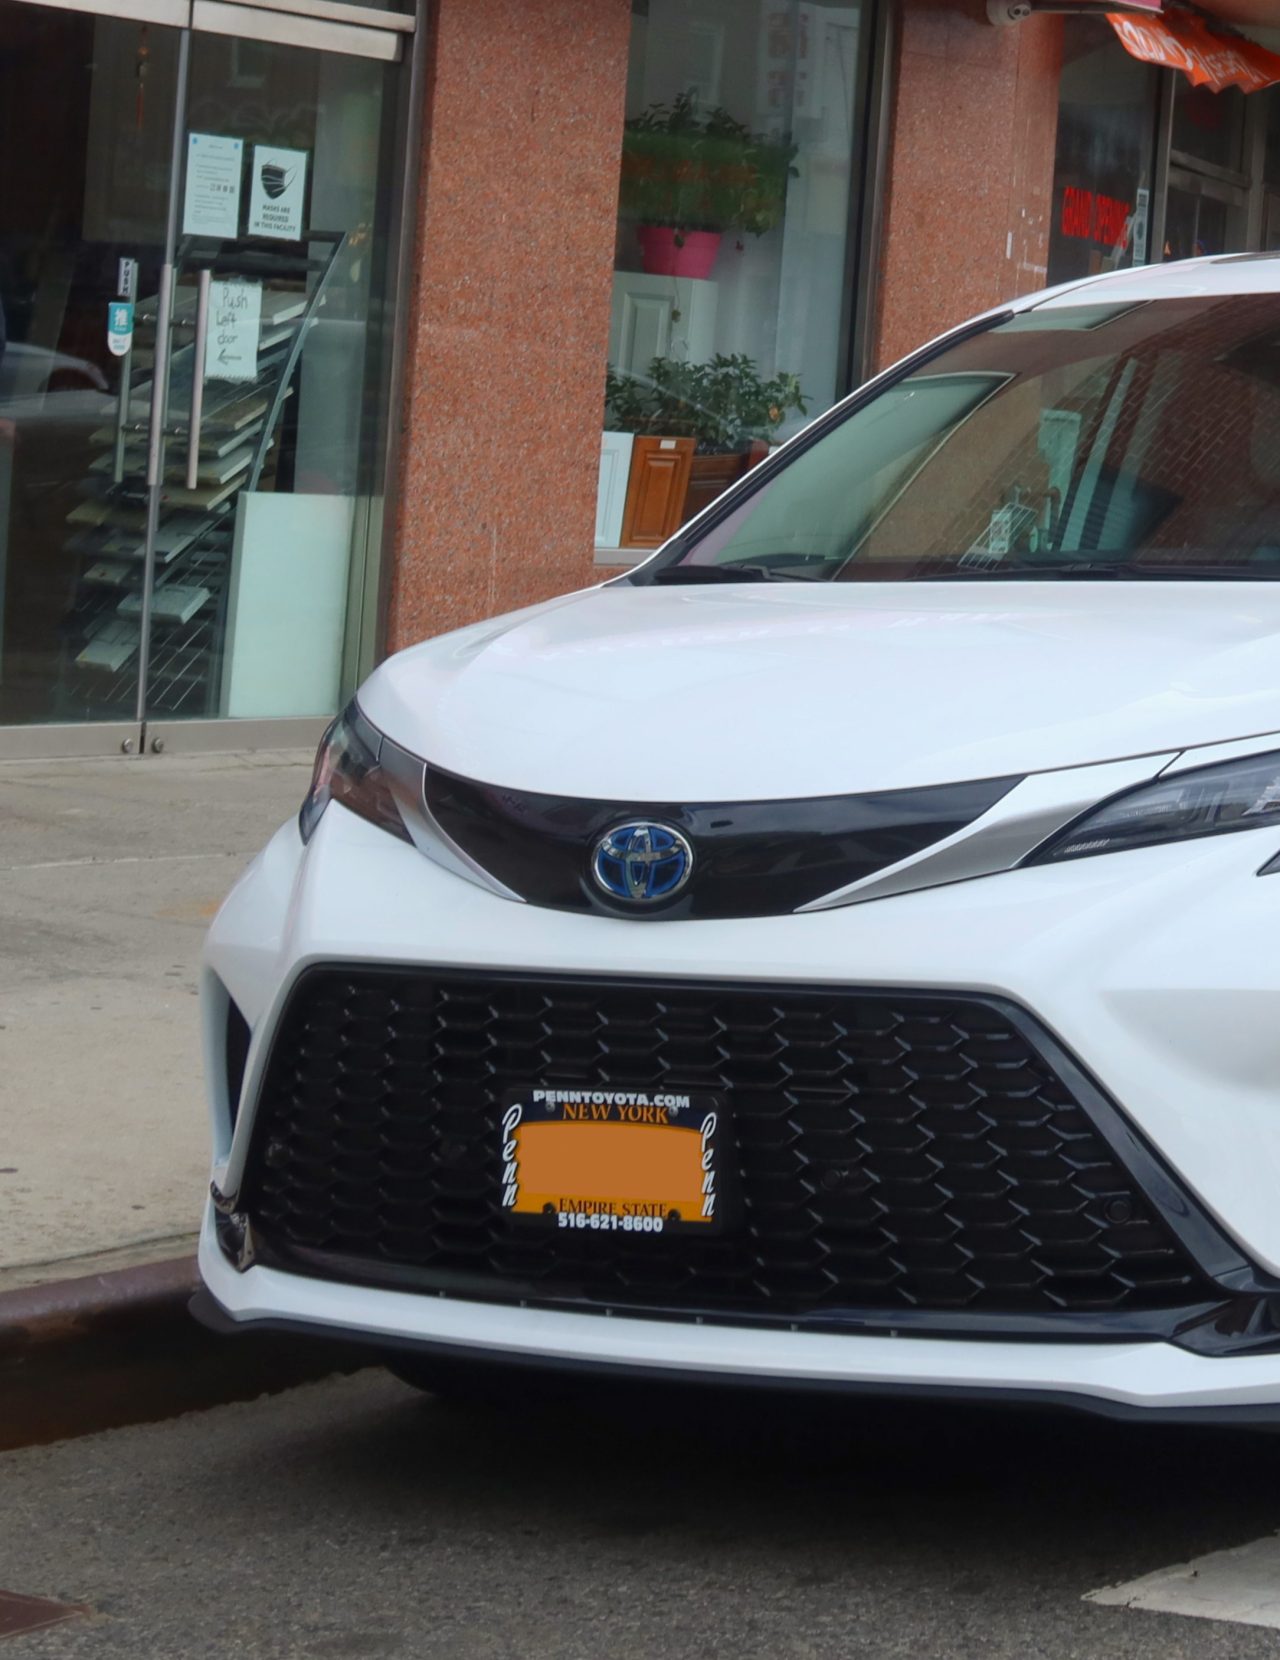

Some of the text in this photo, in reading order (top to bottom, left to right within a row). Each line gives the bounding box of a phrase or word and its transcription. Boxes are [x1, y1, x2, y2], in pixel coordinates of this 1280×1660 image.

[222, 287, 249, 309] Push
[216, 310, 237, 327] Left
[217, 333, 238, 346] door
[533, 1090, 690, 1108] PENNTOYOTA.COM
[563, 1104, 669, 1124] NEW YORK
[502, 1104, 522, 1207] Penn
[700, 1112, 717, 1217] Penn
[559, 1199, 667, 1217] EMPIRE STATE
[558, 1212, 663, 1232] 516-621-8600
